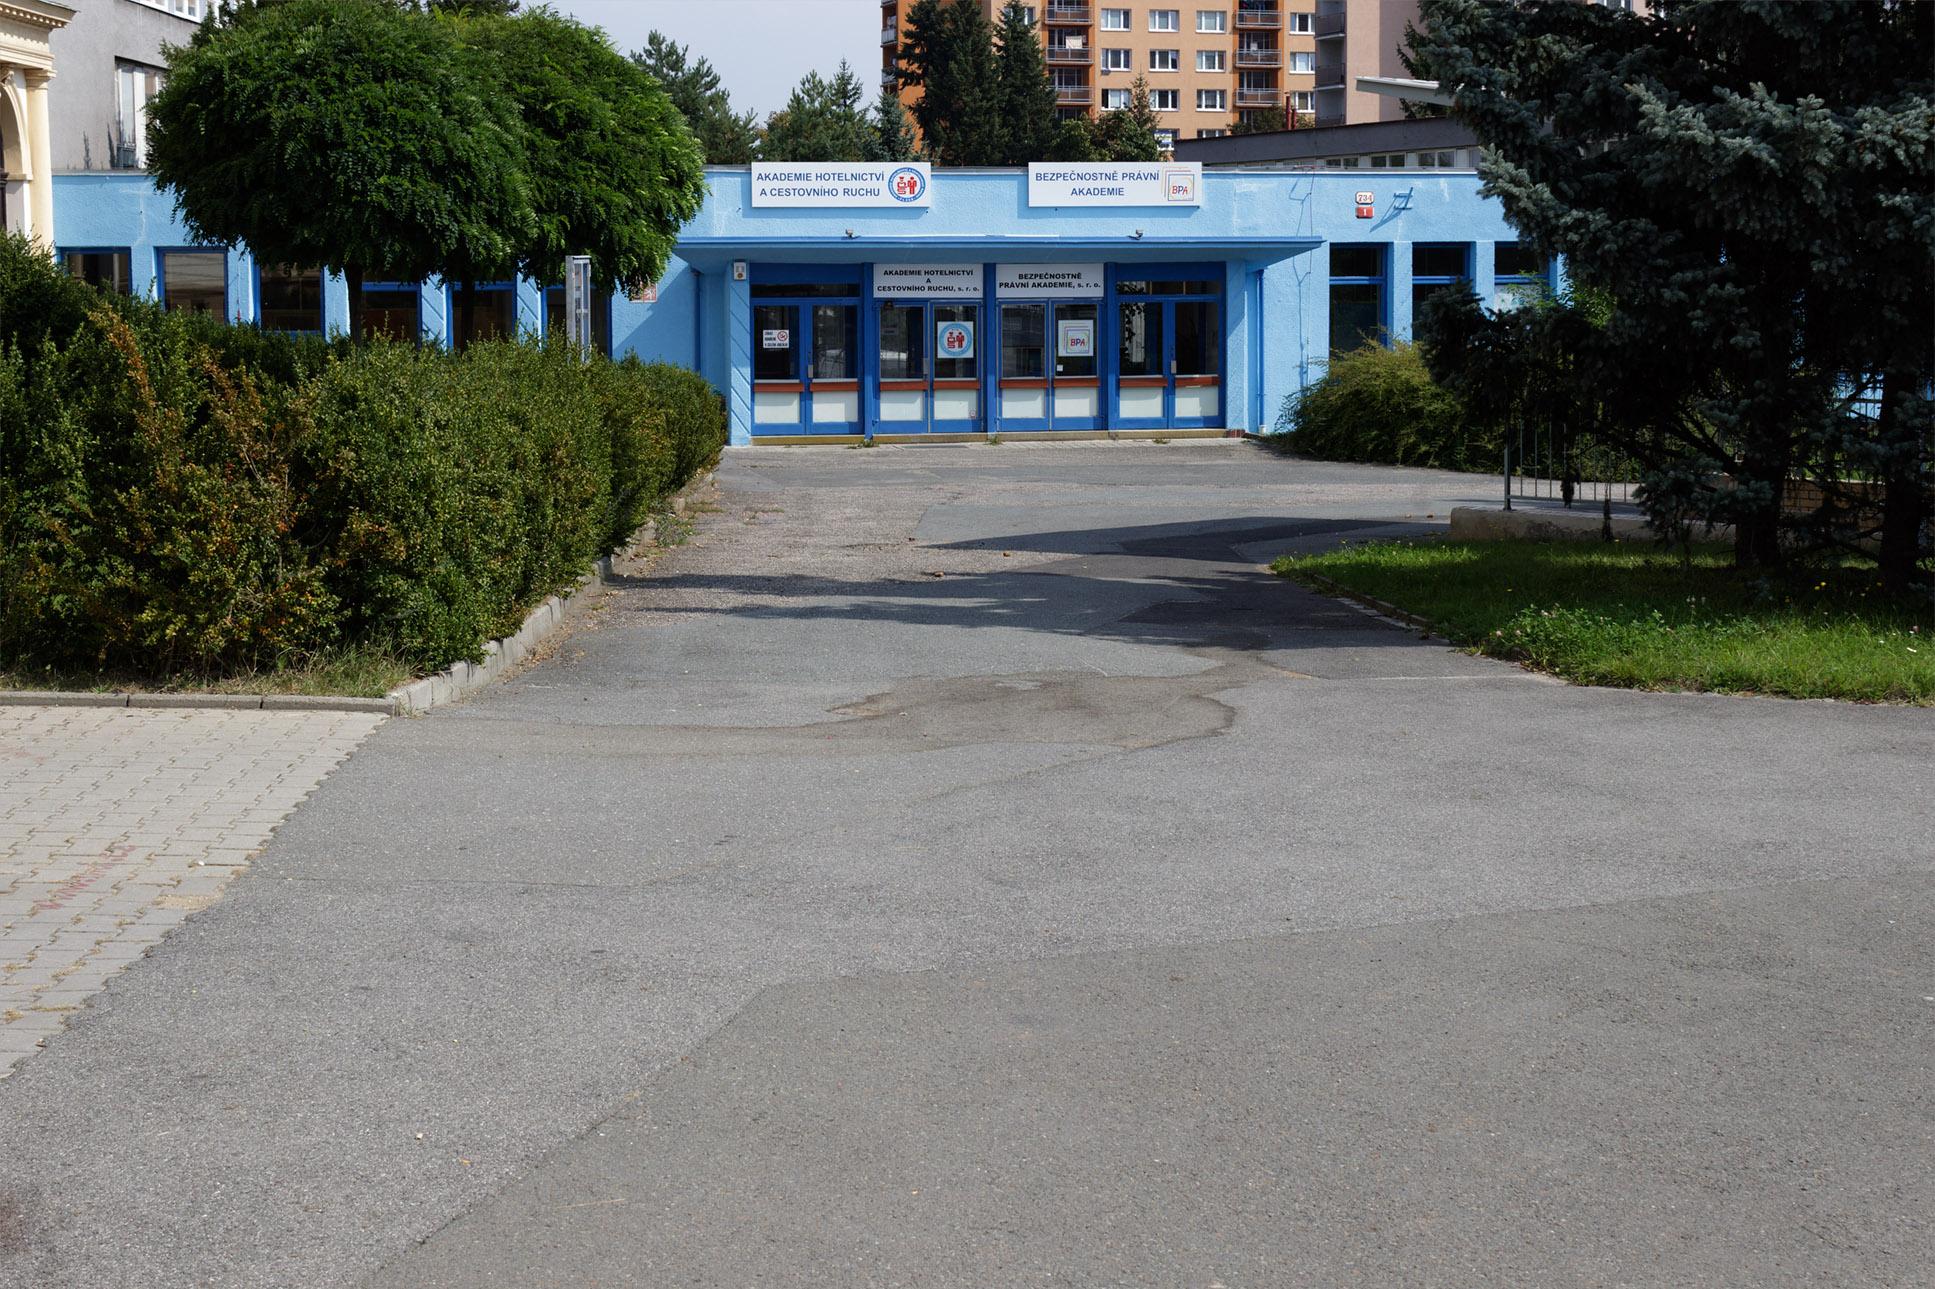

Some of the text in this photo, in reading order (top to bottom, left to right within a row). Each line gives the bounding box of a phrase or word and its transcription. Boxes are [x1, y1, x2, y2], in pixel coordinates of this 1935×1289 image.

[756, 170, 884, 182] AKADEMIE HOTELNICTVÍ
[1035, 169, 1160, 181] BEZPEČNOSTNĚ PRÁVNÍ
[759, 185, 880, 197] A CESTOVNÍHO RUCHU
[1070, 187, 1125, 196] AKADEMIE
[1171, 185, 1189, 195] BPA
[1359, 194, 1373, 202] 734
[924, 268, 974, 276] HOTELNICTVÍ
[1018, 272, 1082, 280] BEZPEČNOSTNĚ
[1031, 281, 1075, 289] AKADEMIE,
[1070, 338, 1085, 347] BPA
